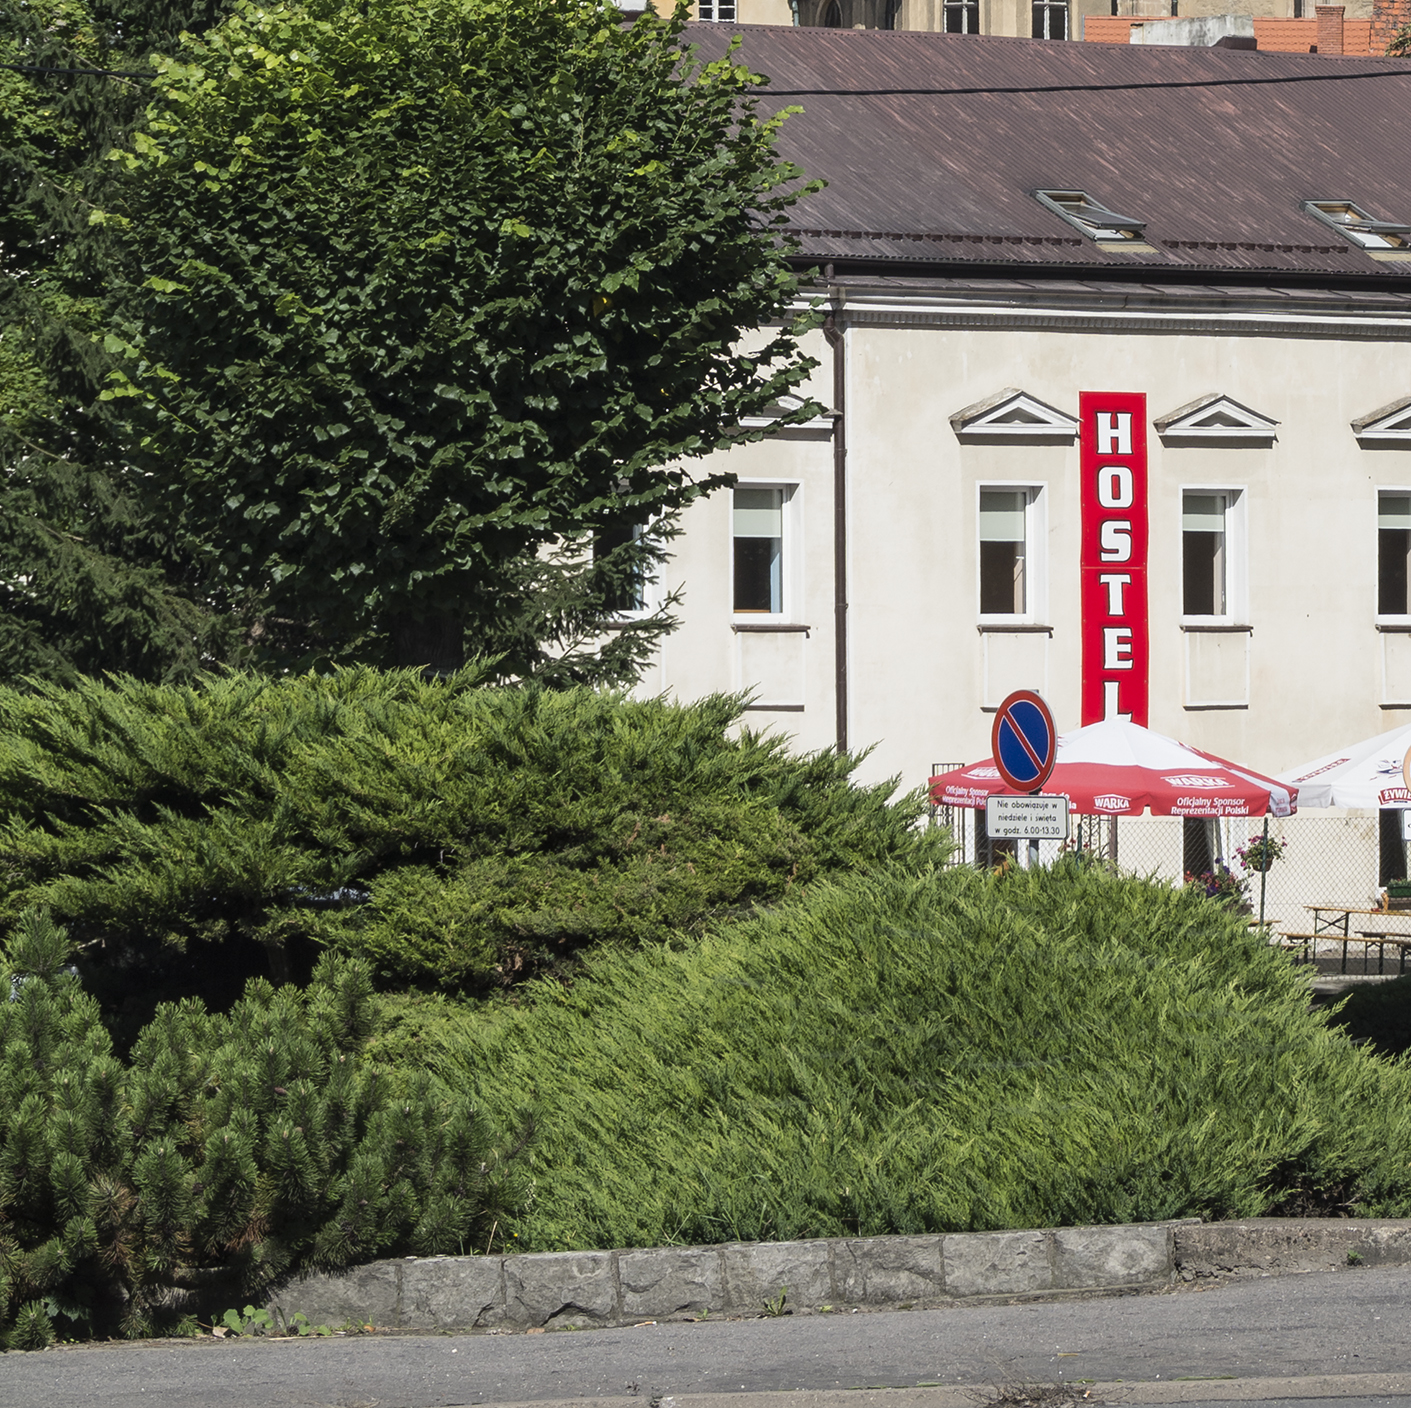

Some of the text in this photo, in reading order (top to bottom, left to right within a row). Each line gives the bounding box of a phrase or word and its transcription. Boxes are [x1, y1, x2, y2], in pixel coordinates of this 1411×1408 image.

[1096, 411, 1135, 723] HOSTEL
[1165, 776, 1230, 787] WARKA
[997, 800, 1009, 809] Nie
[1011, 800, 1049, 811] obowiązuje
[1094, 797, 1130, 809] WARKA
[1177, 796, 1245, 808] Oficjalny Sponsor
[1171, 805, 1249, 817] Reprezentacji Polski
[998, 813, 1027, 822] niedziele
[1035, 813, 1057, 824] święta
[1003, 826, 1021, 836] godz.
